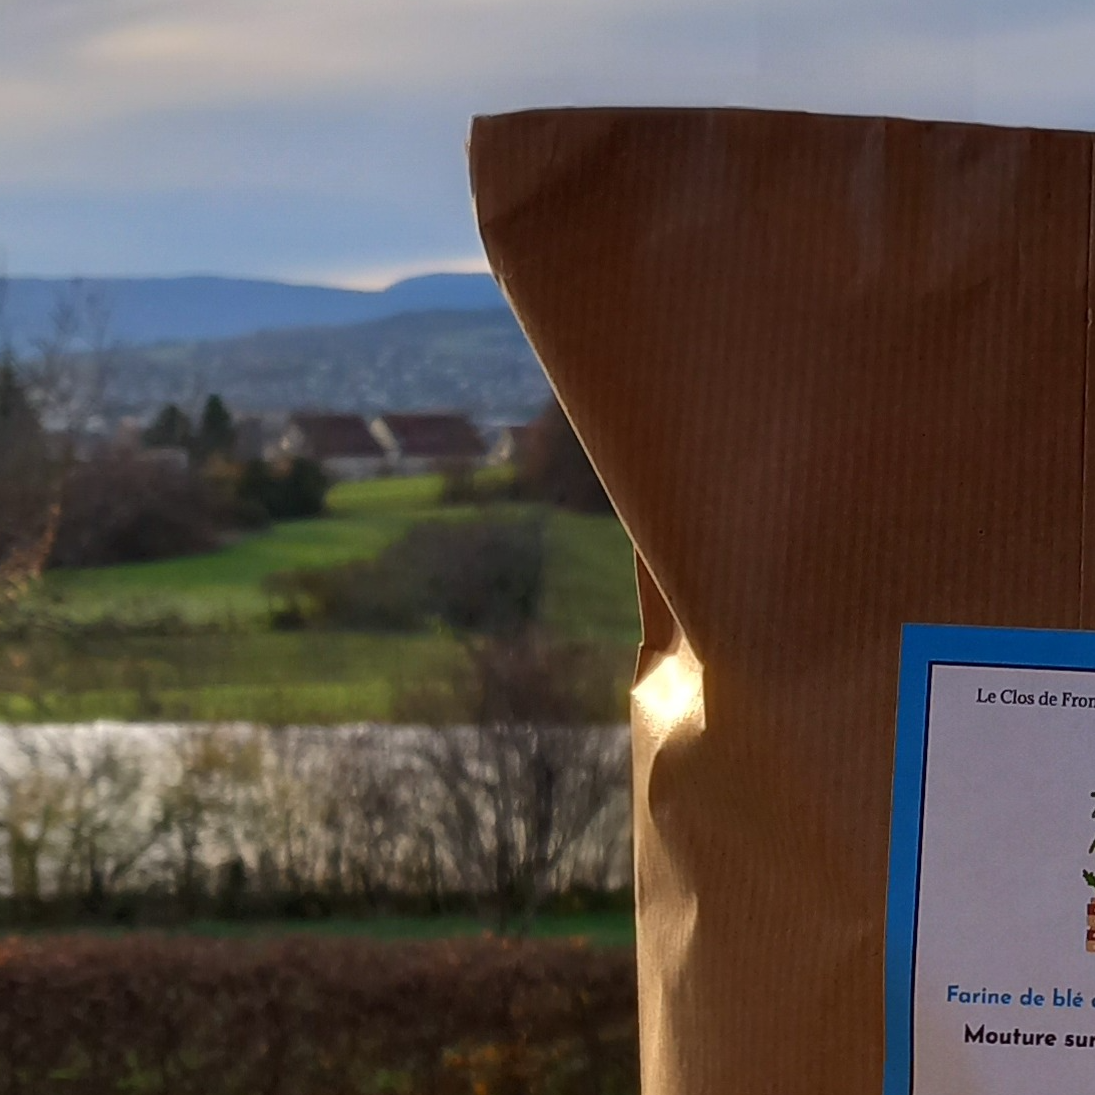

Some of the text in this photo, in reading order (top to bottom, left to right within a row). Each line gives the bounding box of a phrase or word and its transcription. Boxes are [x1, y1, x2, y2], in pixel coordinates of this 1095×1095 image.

[977, 688, 997, 704] Le
[1000, 689, 1035, 705] Clos
[1038, 691, 1058, 706] de
[947, 985, 1012, 1005] Farine
[1020, 987, 1045, 1006] de
[1053, 988, 1083, 1007] blé
[964, 1024, 1057, 1046] Mouture
